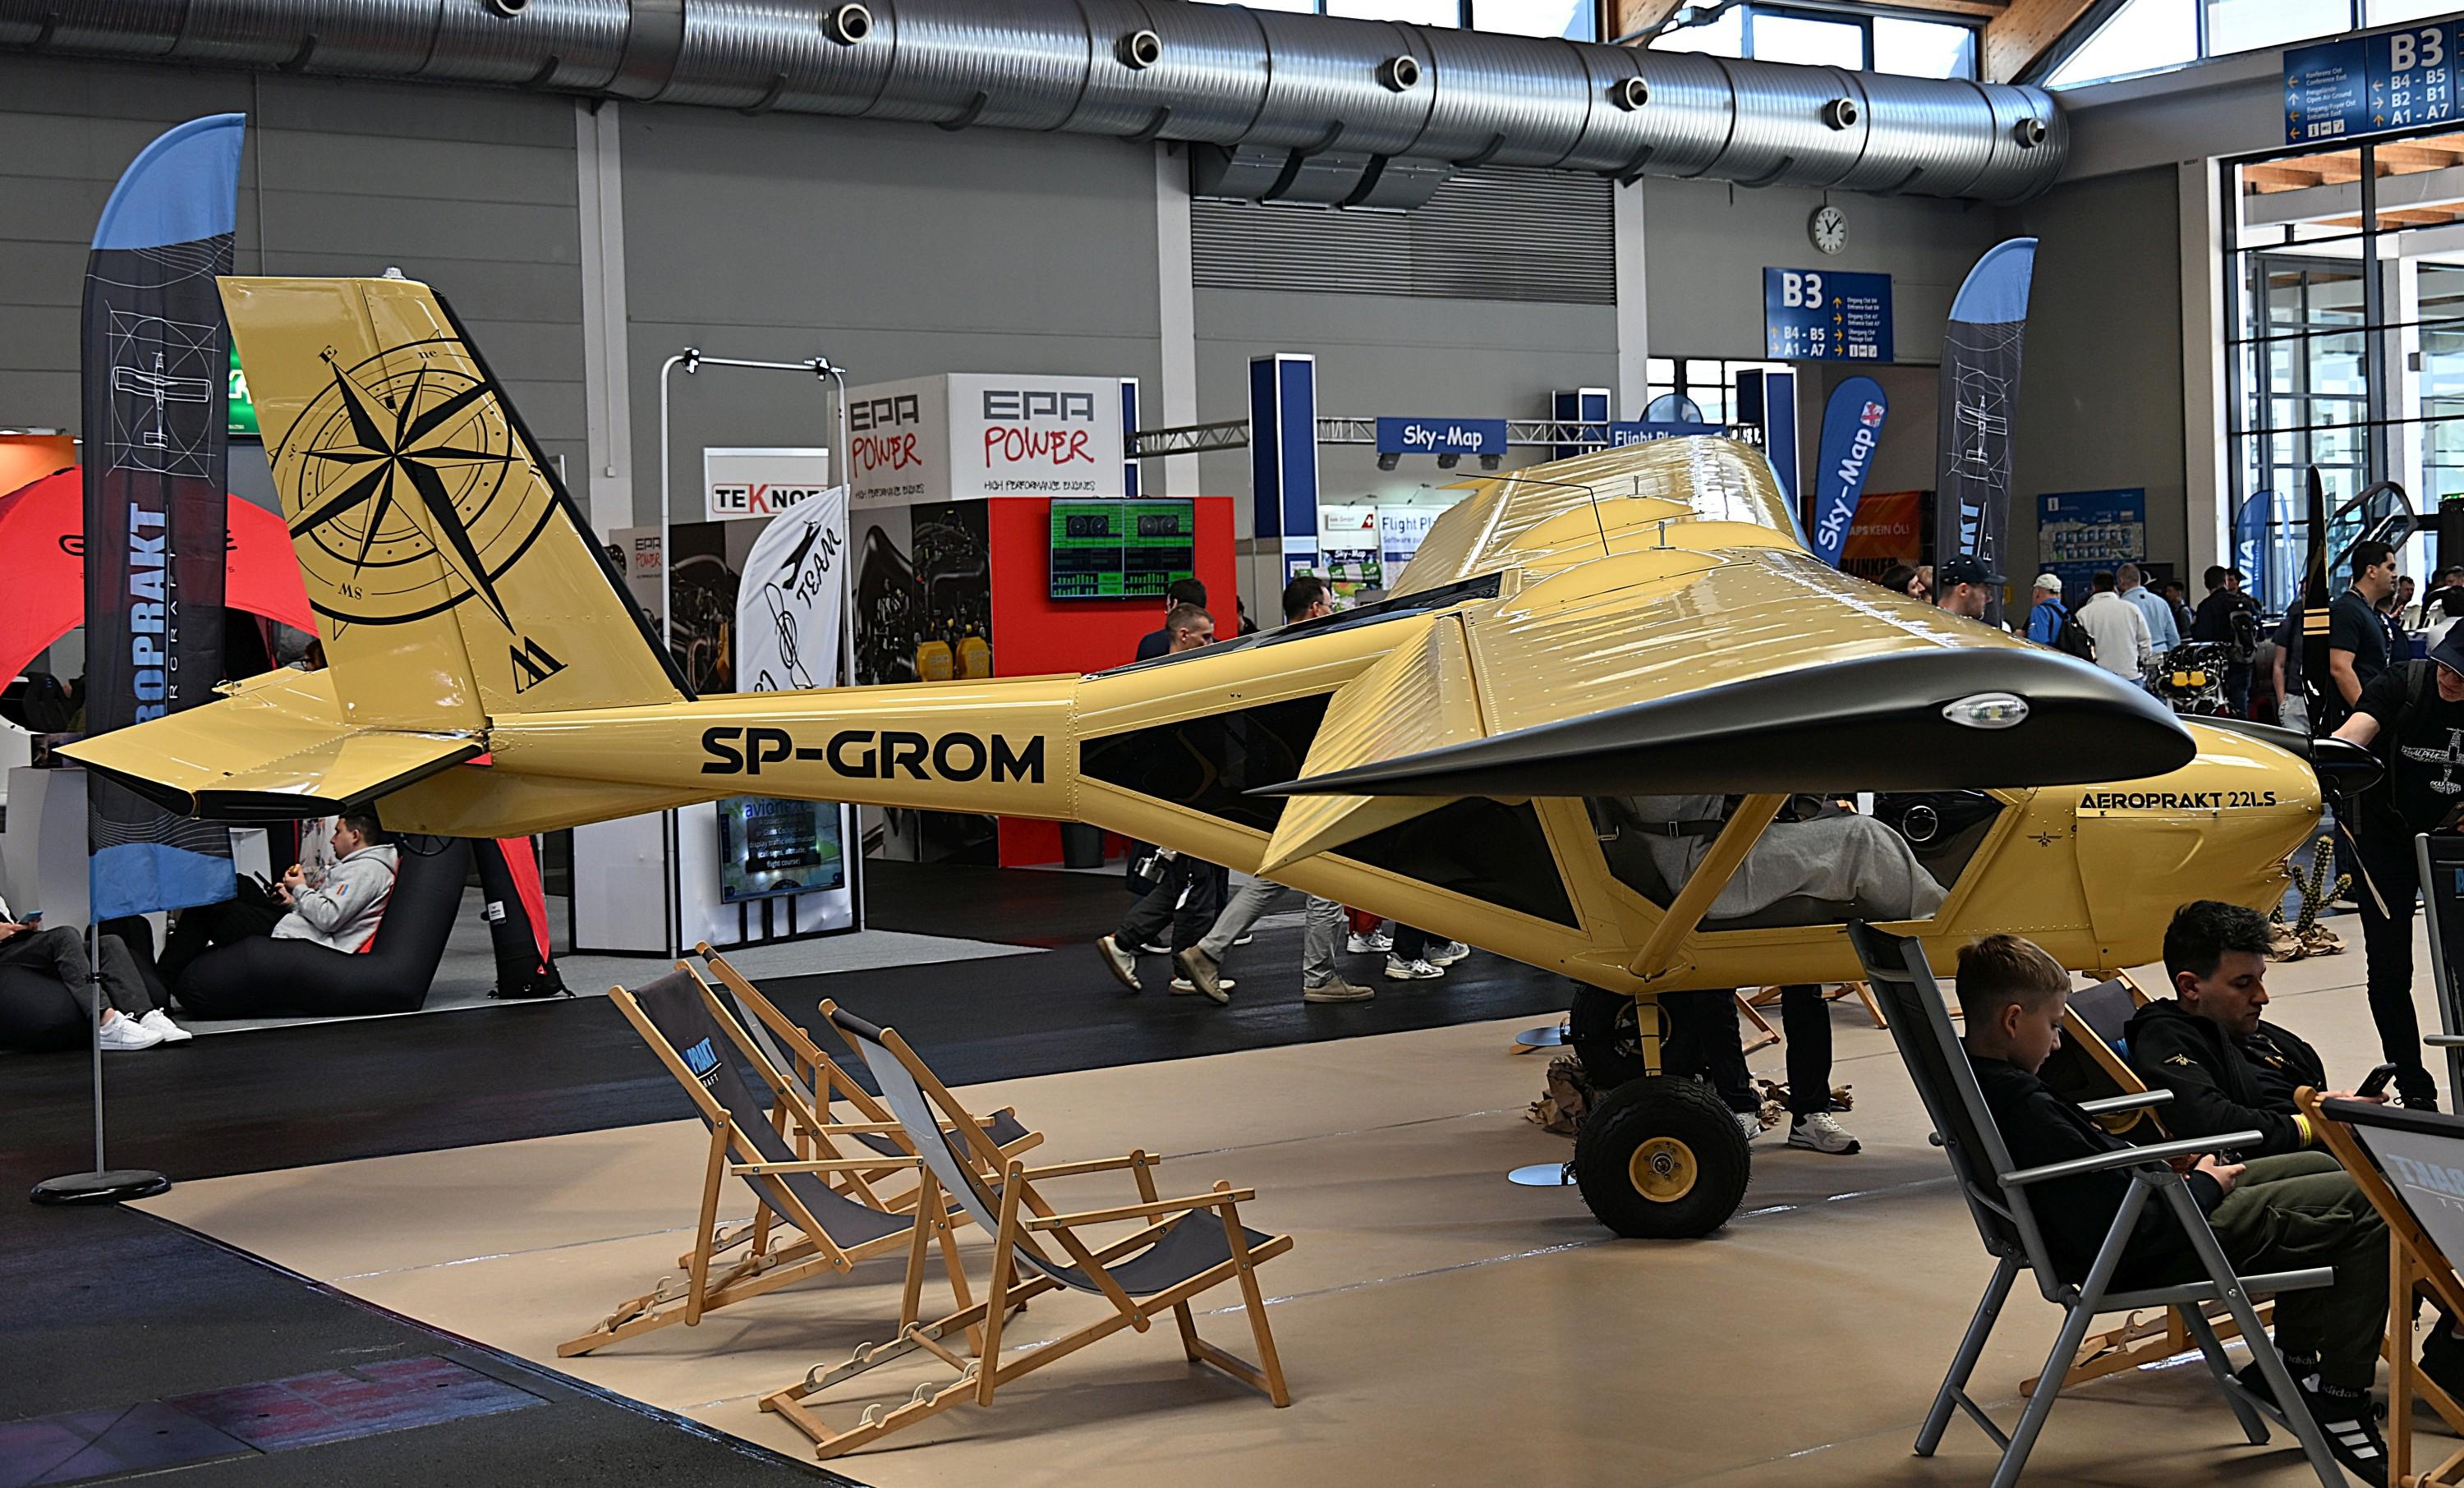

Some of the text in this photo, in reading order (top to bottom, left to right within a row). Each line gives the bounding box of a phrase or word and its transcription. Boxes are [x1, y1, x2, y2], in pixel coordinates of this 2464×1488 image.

[2391, 28, 2443, 72] B3
[2391, 74, 2410, 90] B4
[2426, 68, 2446, 85] B5
[2306, 96, 2321, 104] Open
[2332, 89, 2351, 99] Ground
[2391, 91, 2411, 108] B2
[2427, 85, 2446, 102] B1
[2392, 109, 2411, 125] A1
[2427, 103, 2449, 120] A7
[1783, 273, 1823, 309] B3
[1784, 326, 1799, 340] B4
[1809, 328, 1825, 341] B5
[1784, 342, 1799, 356] A1
[1809, 343, 1825, 356] A7
[849, 394, 919, 432] EPA
[984, 390, 1094, 422] EPA
[985, 426, 1095, 468] POWER
[1404, 424, 1483, 452] Sky-Map
[852, 432, 922, 479] POWER
[985, 480, 1096, 491] HIGH PERFORMANCE ENGINES
[1818, 428, 1876, 552] Sky-Map
[715, 484, 825, 512] TEKNO
[1381, 517, 1417, 534] Flight
[1869, 526, 1891, 535] KEIN
[635, 537, 661, 550] EPA
[1334, 549, 1367, 559] Sky-Map
[636, 552, 662, 570] POWER
[796, 527, 842, 609] TEAM
[701, 726, 1045, 784] SP-GROM
[2080, 791, 2277, 809] AEROPRAKT 22LS
[749, 838, 768, 850] display
[766, 860, 781, 869] flight
